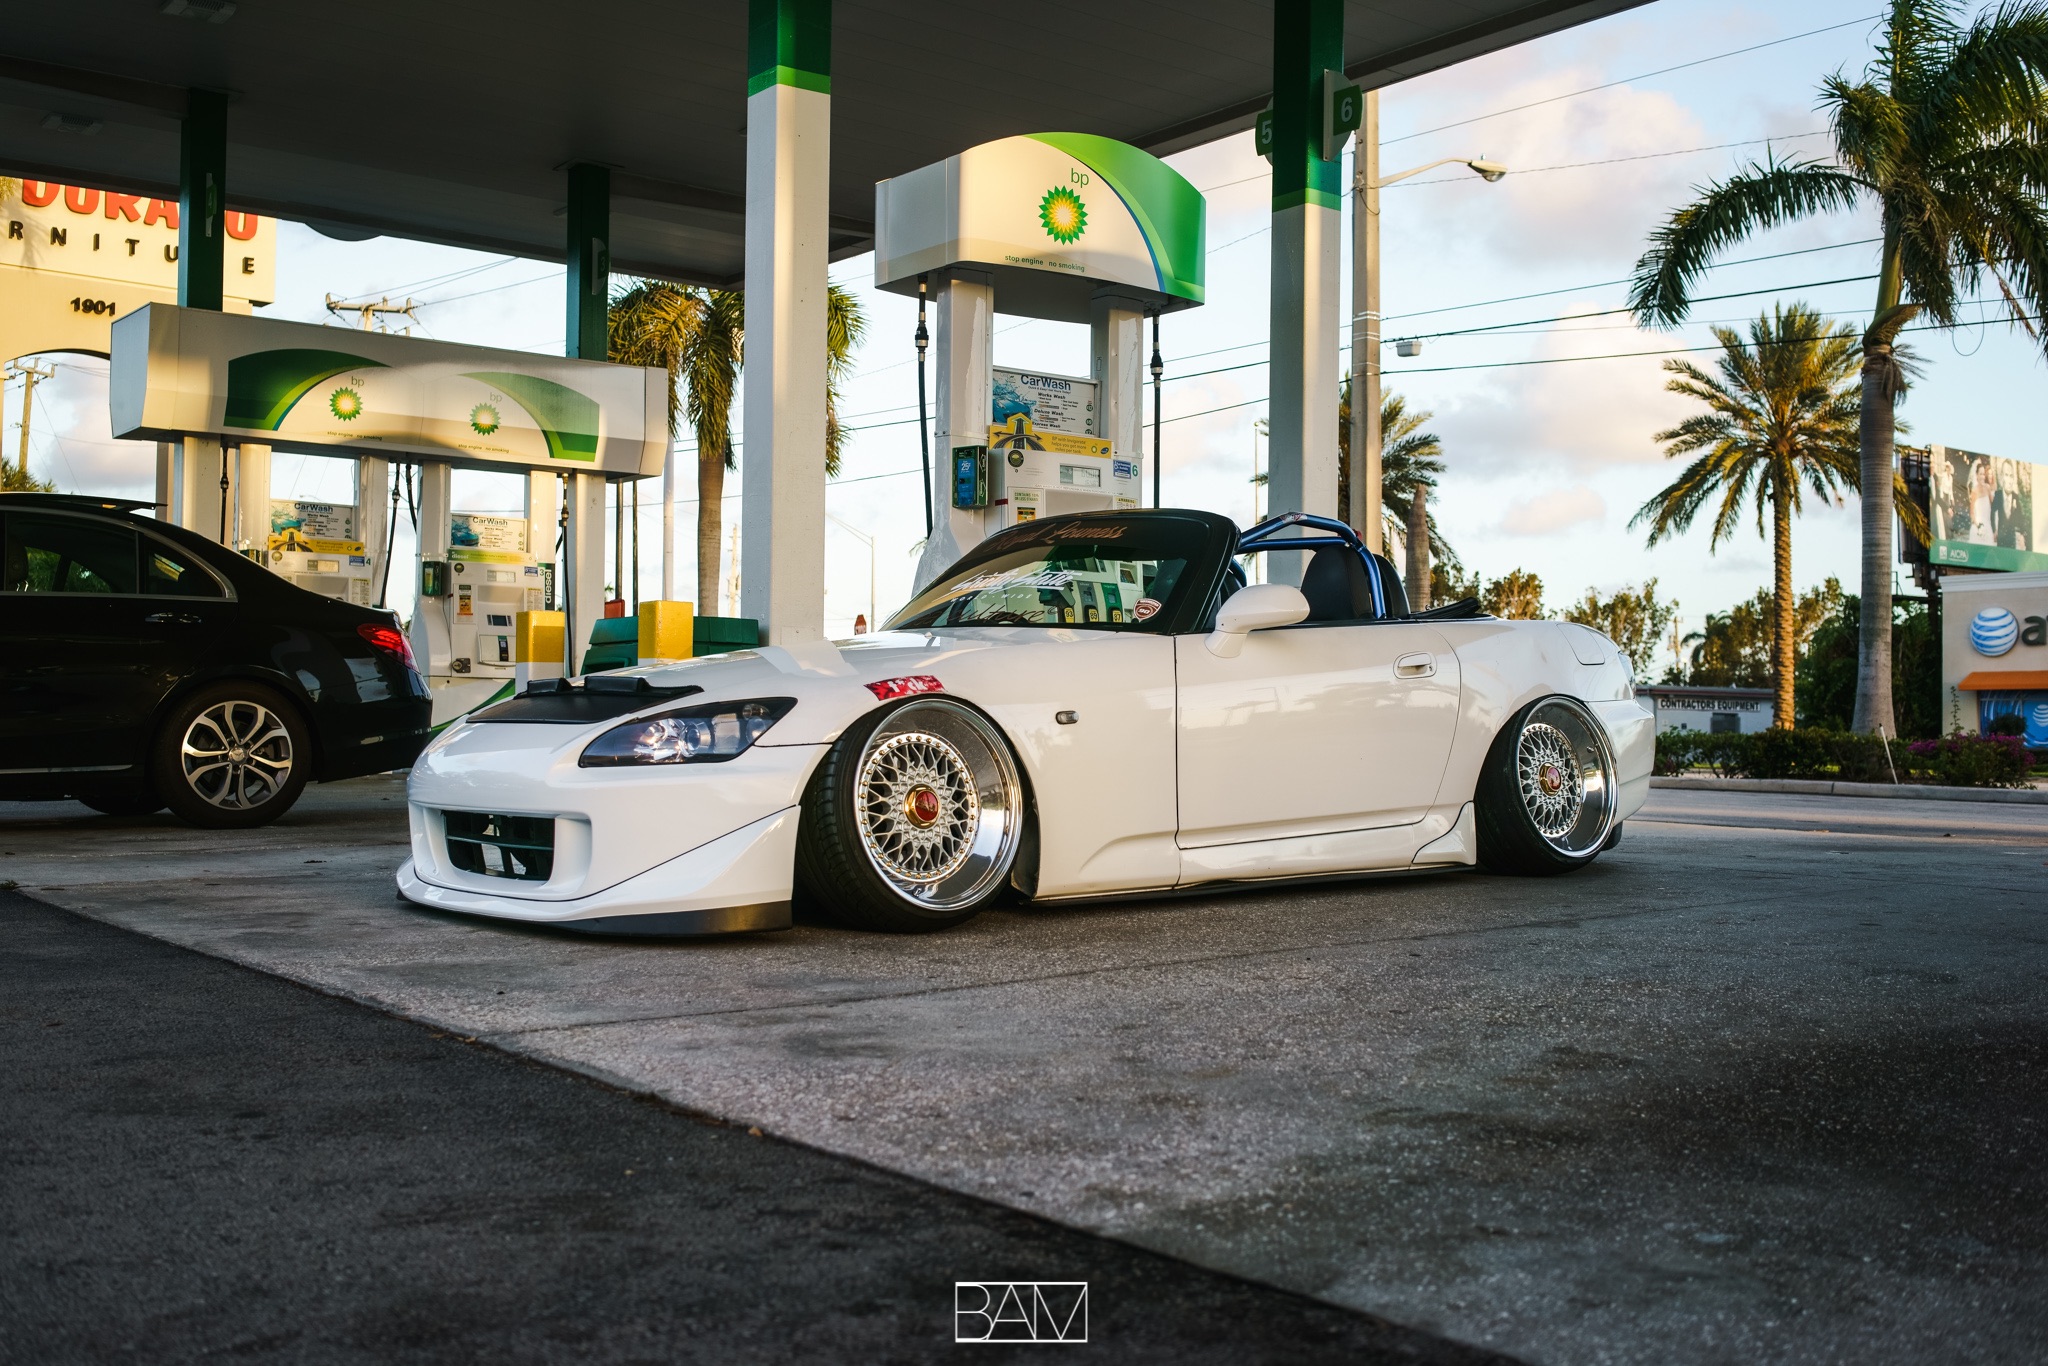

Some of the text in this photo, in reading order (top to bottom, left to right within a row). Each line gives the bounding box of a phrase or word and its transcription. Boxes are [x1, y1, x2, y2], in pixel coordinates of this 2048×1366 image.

[1340, 96, 1353, 123] 6
[1261, 119, 1273, 145] 5
[1070, 167, 1090, 188] bp
[8, 219, 256, 275] RNITUE
[1004, 254, 1086, 273] stop engine no smoking
[70, 296, 116, 317] 1901
[351, 375, 365, 388] bp
[1020, 374, 1071, 391] CarWash
[489, 391, 503, 403] bp
[337, 431, 354, 439] engine
[363, 434, 383, 442] smoking
[1131, 465, 1139, 477] 6
[294, 502, 334, 513] CarWash
[472, 516, 508, 526] CarWash
[365, 558, 371, 566] 4
[539, 568, 545, 577] 3
[545, 569, 553, 604] diesel
[1065, 610, 1074, 618] 93
[2021, 615, 2048, 646] a
[1660, 699, 1760, 711] CONTRACTORS EQUIPMENT
